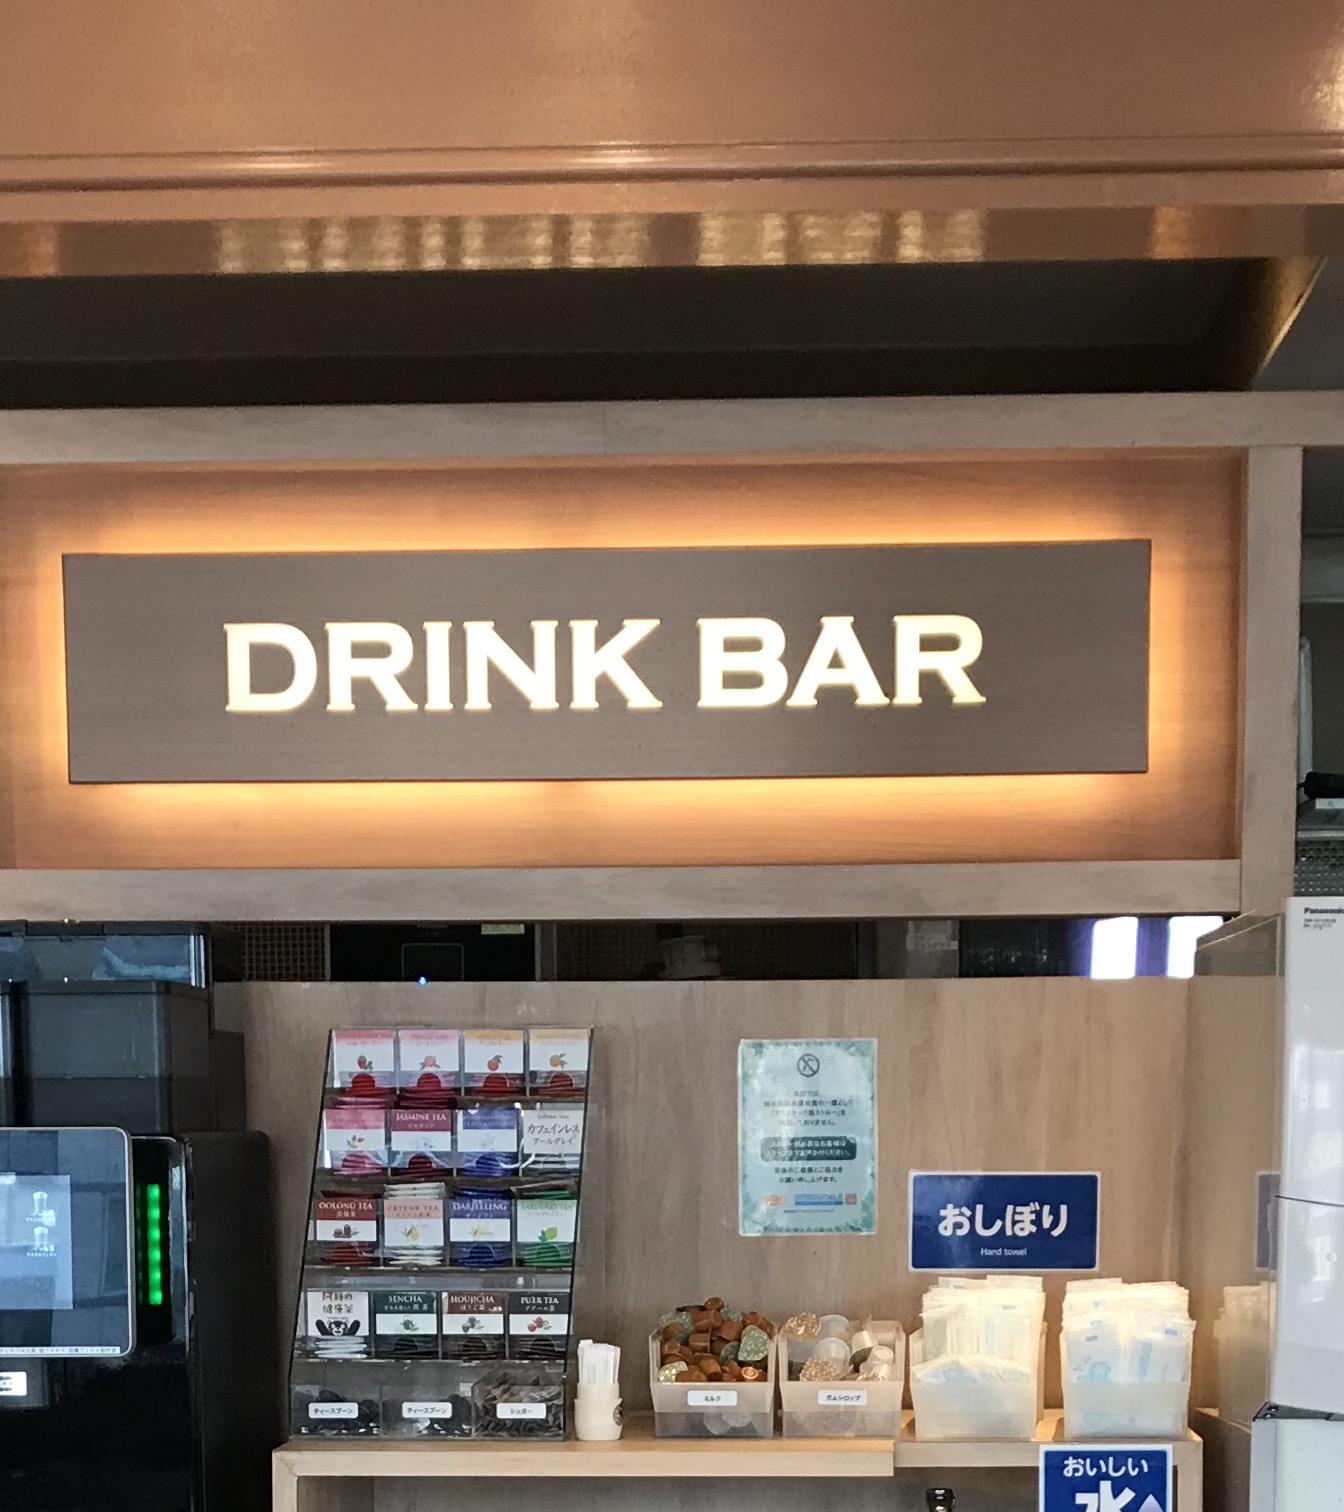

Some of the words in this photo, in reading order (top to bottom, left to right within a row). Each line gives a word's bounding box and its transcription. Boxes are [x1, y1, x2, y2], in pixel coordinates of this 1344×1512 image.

[223, 618, 664, 714] DRINK
[696, 614, 986, 708] BAR
[396, 1112, 430, 1121] JASMINE
[432, 1112, 447, 1121] TEA
[527, 1124, 581, 1135] カフェインレス
[318, 1201, 356, 1210] OOLONG
[358, 1201, 373, 1210] TEA
[453, 1201, 507, 1212] DARJEELING
[938, 1202, 1068, 1237] おしぼり
[981, 1248, 1002, 1256] Hand
[1004, 1248, 1027, 1256] towel
[388, 1296, 422, 1304] SENCHA
[450, 1296, 495, 1305] HOUJICHA
[544, 1296, 559, 1304] TEA
[1063, 1456, 1148, 1477] おいしい
